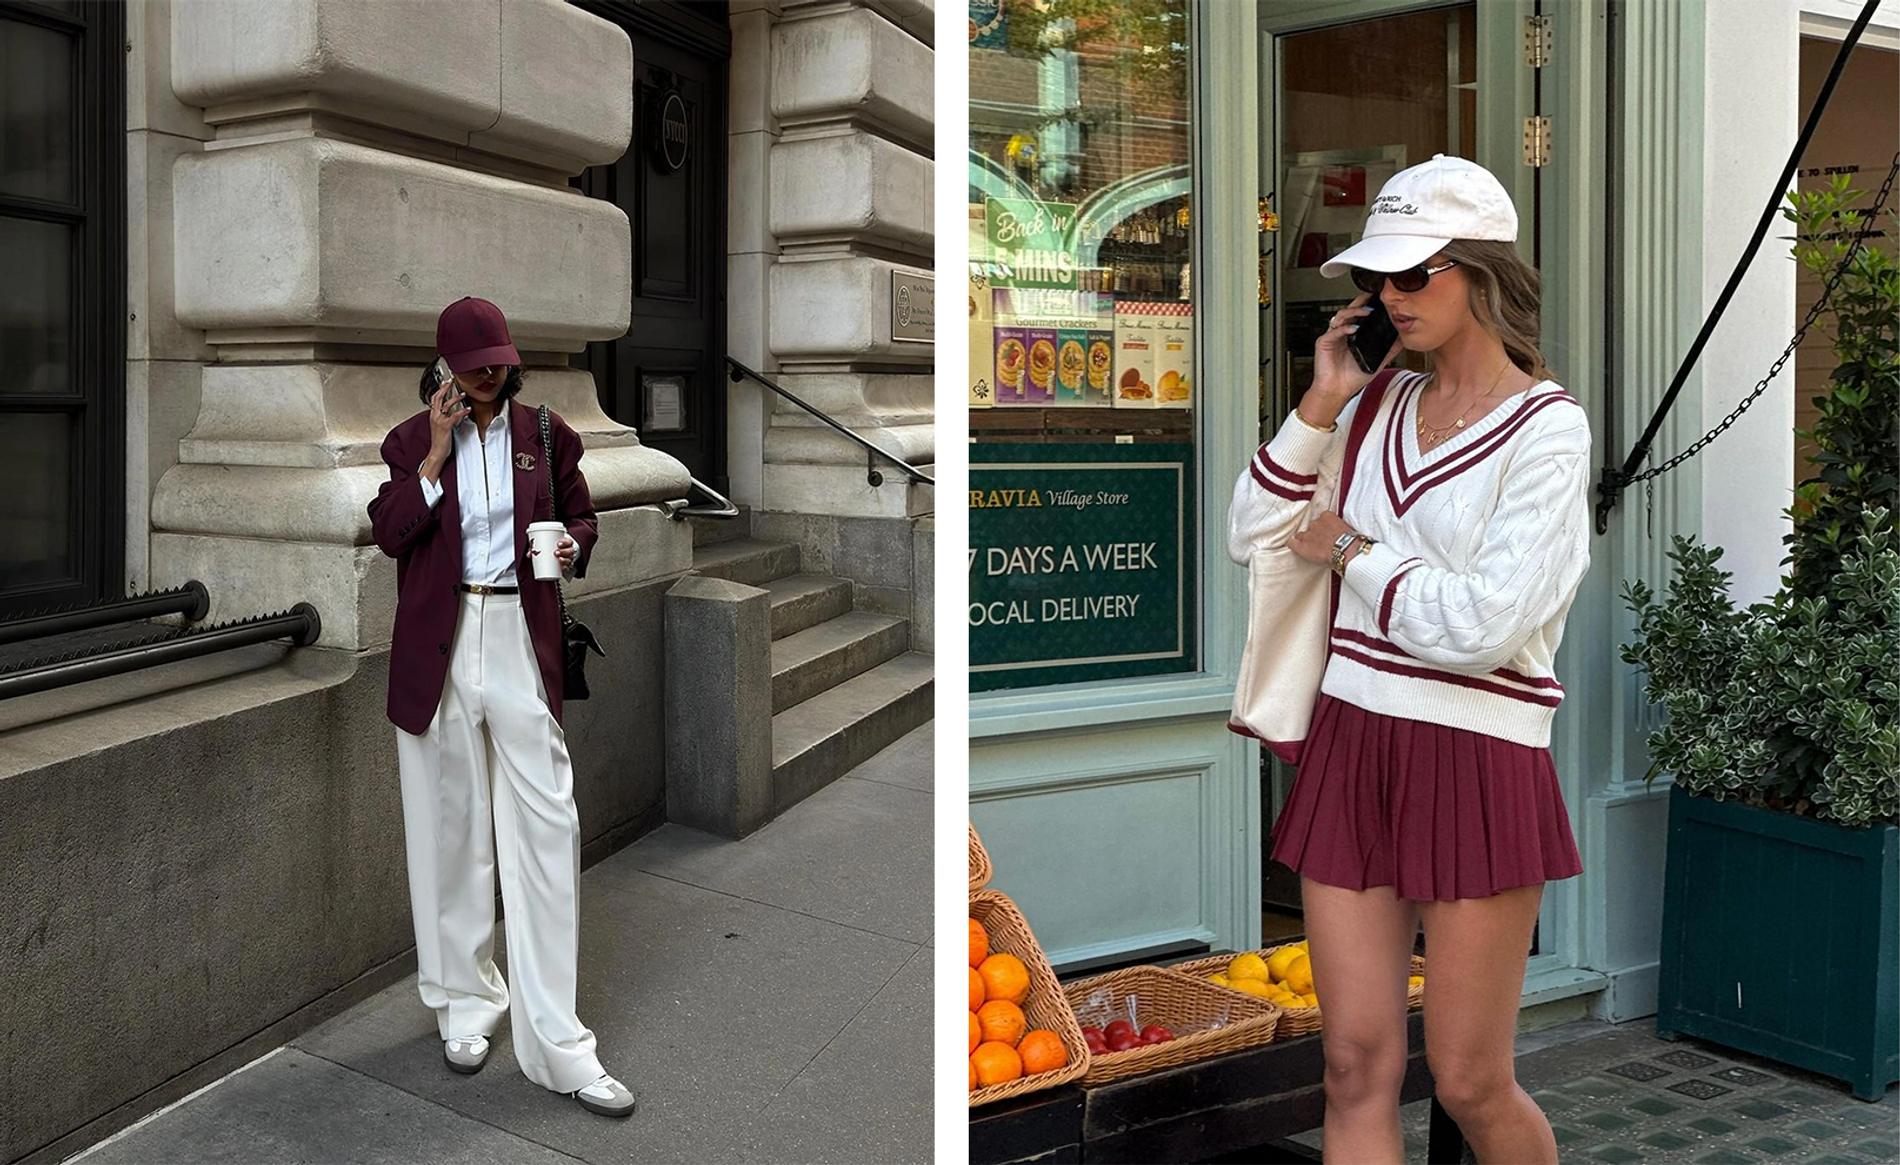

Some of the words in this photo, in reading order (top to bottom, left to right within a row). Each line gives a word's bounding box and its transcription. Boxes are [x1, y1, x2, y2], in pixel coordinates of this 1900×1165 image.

[996, 207, 1045, 242] Back
[1052, 213, 1068, 232] in
[1014, 248, 1072, 284] MINS
[969, 490, 1043, 508] RAVIA
[1046, 489, 1093, 510] Village
[1096, 490, 1129, 505] Store
[987, 545, 1055, 576] DAYS
[1059, 545, 1080, 572] A
[1083, 542, 1158, 571] WEEK
[1041, 594, 1140, 622] DELIVERY
